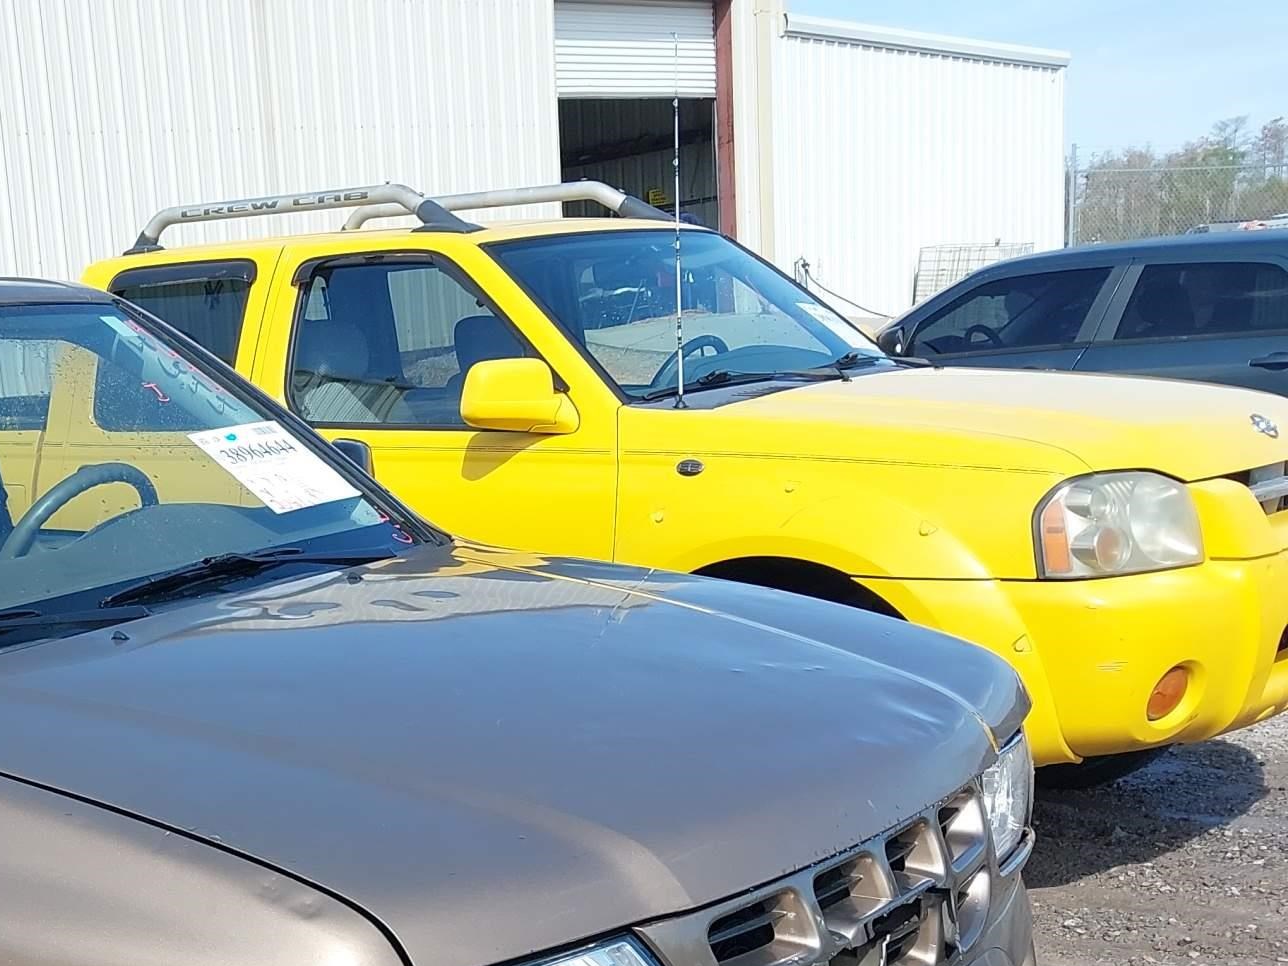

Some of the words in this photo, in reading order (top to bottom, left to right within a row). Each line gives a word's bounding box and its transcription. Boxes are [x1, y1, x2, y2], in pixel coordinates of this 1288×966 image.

[180, 200, 280, 218] CREW
[292, 191, 369, 206] CAB
[218, 438, 298, 465] 38964644
